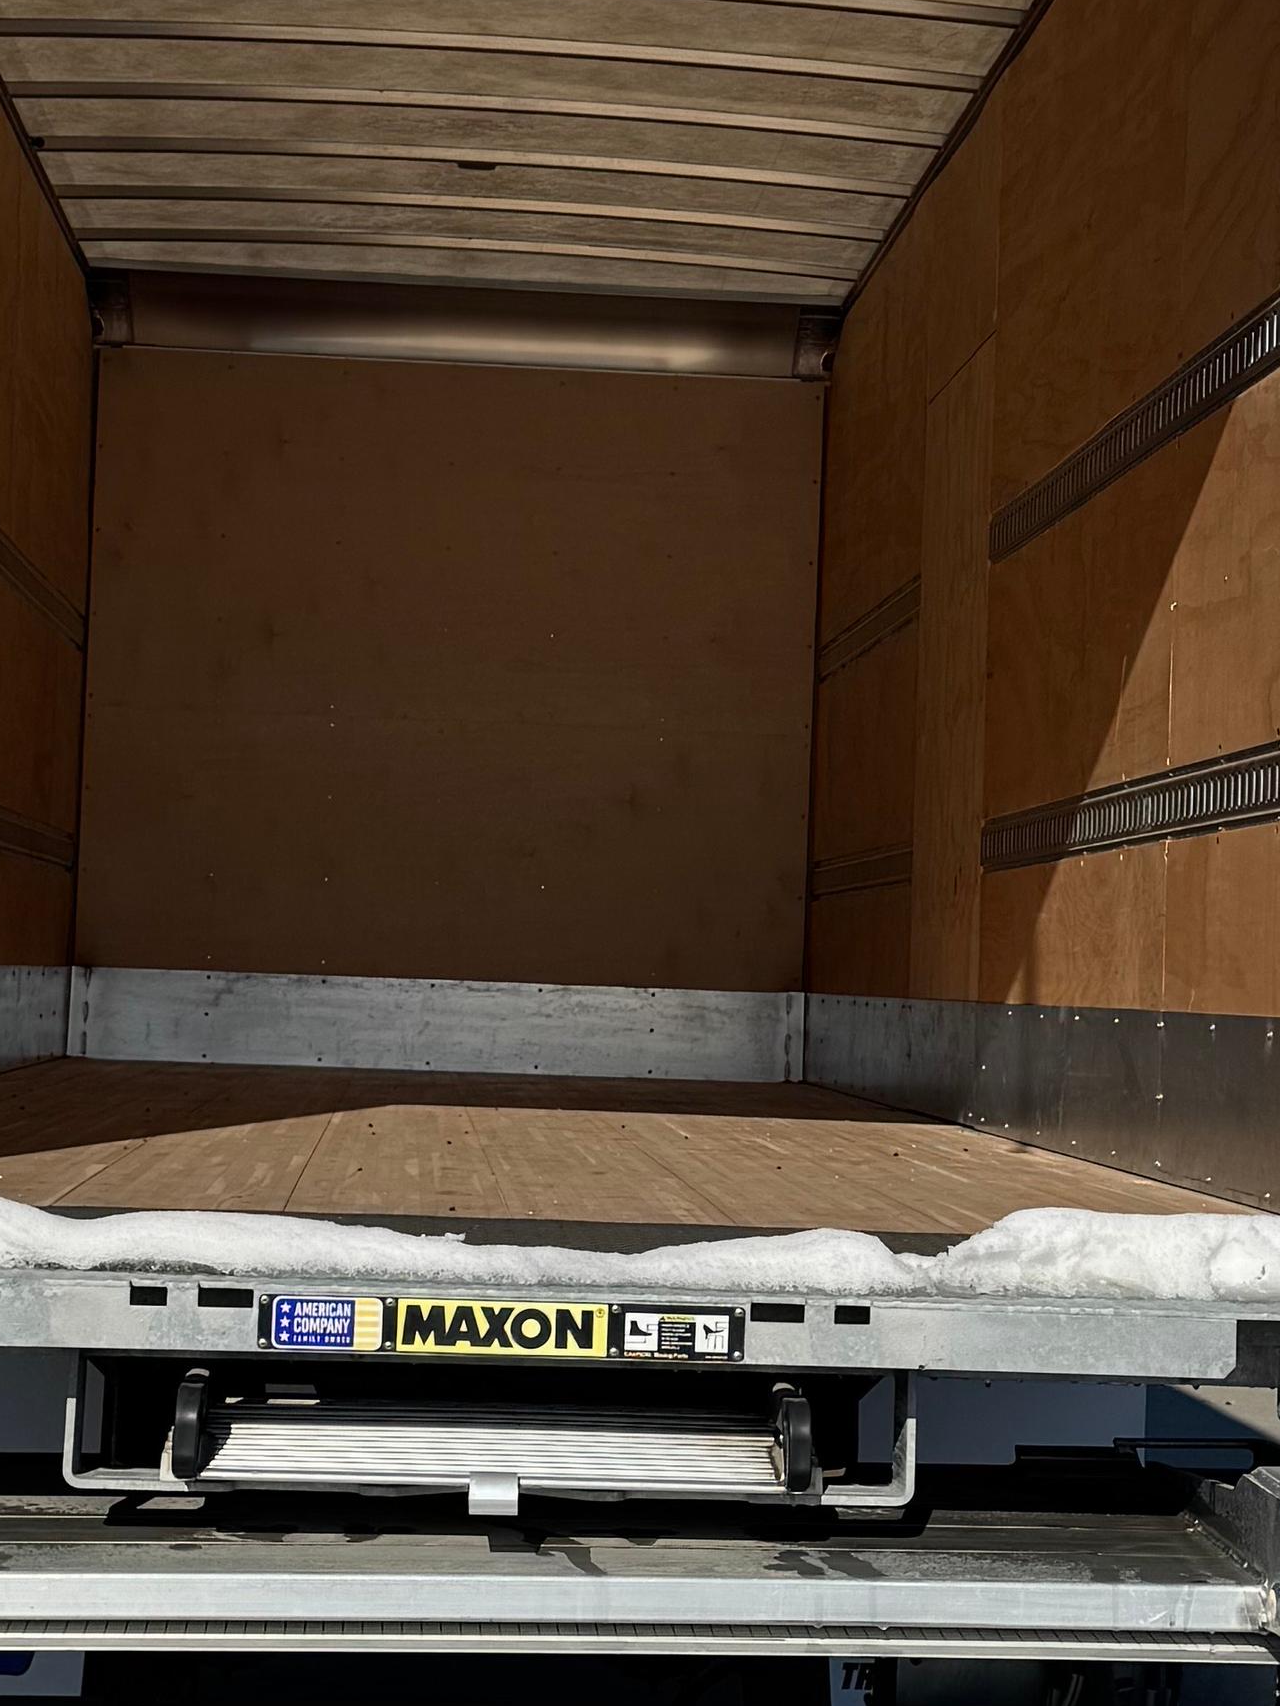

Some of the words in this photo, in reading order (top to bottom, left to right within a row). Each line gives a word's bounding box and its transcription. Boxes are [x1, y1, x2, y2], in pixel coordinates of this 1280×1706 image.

[294, 1302, 351, 1317] AMERICAN
[293, 1318, 350, 1334] COMPANY
[401, 1305, 594, 1349] MAXON
